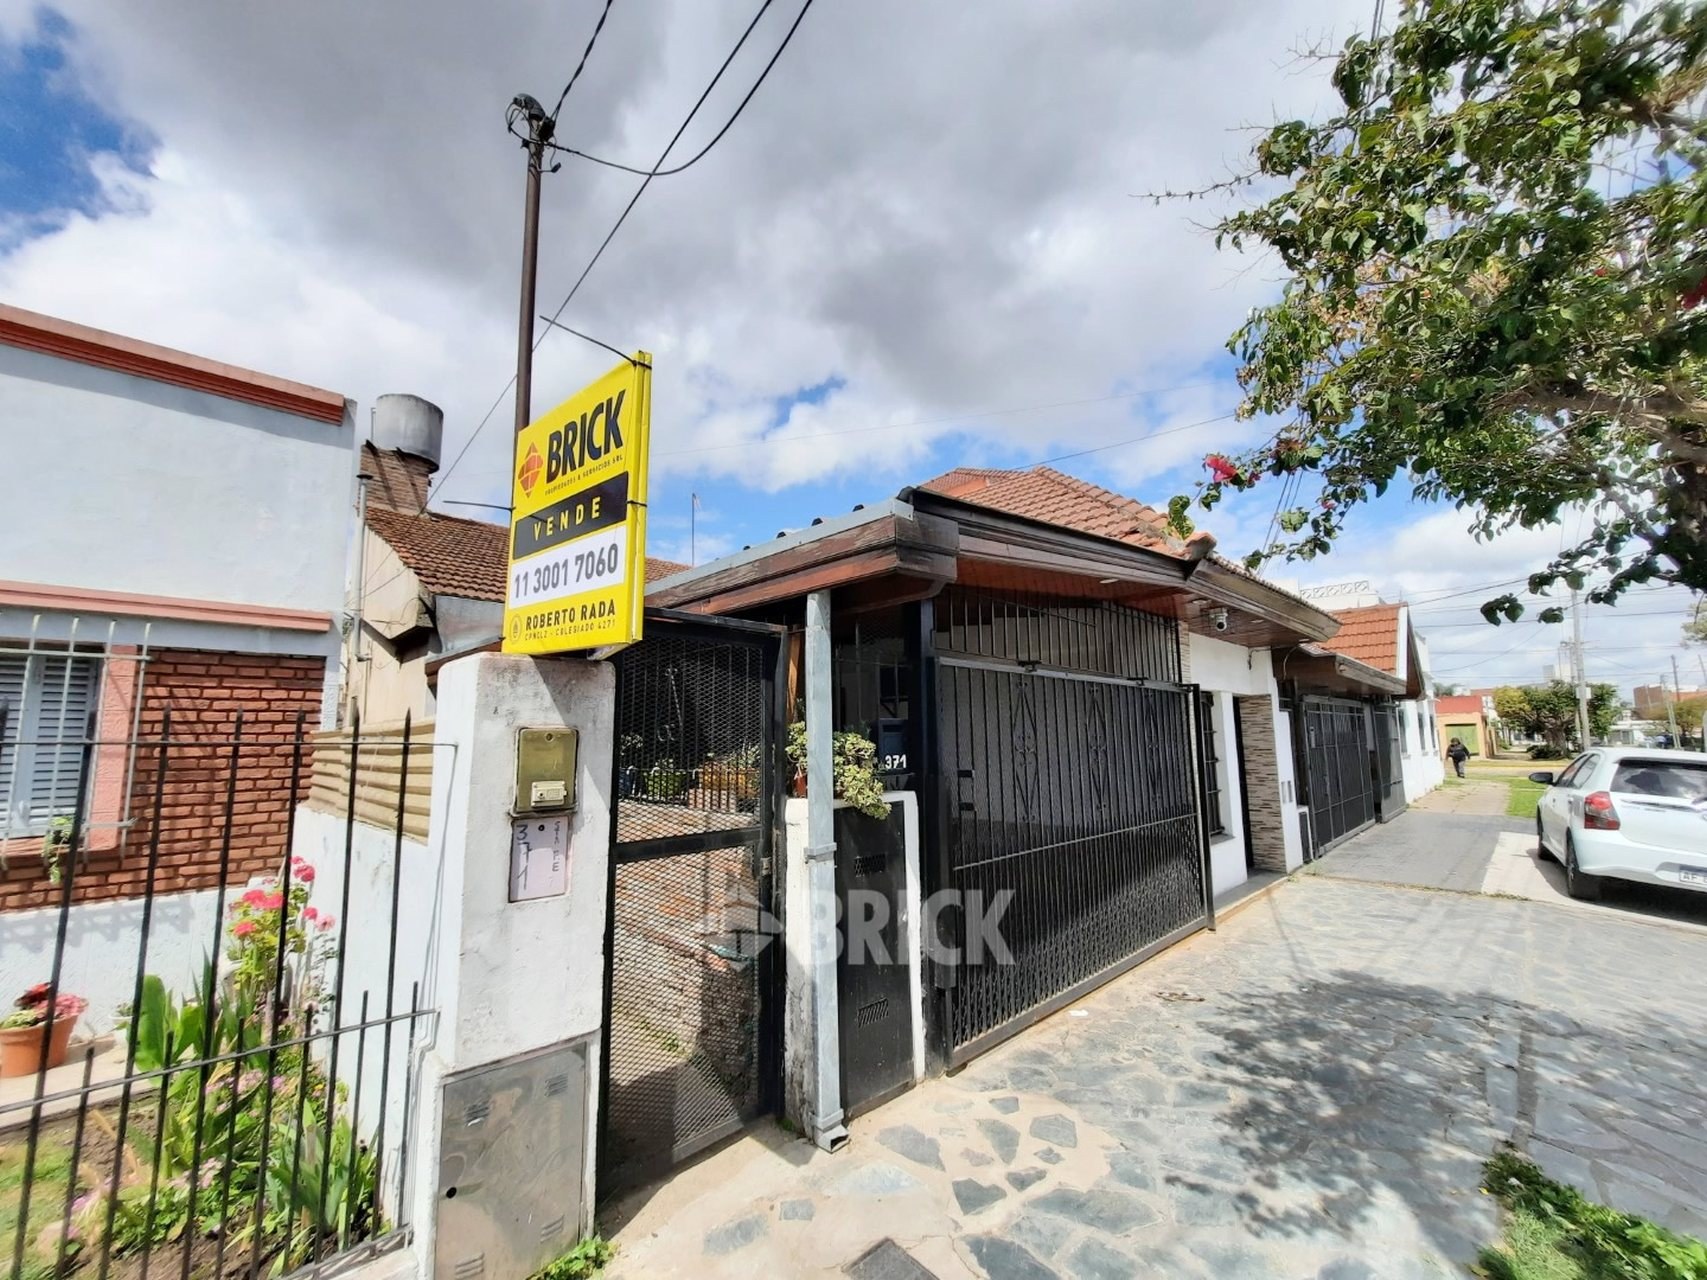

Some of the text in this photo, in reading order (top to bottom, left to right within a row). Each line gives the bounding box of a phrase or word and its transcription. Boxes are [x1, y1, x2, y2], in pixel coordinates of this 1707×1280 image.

[546, 389, 626, 484] BRICK
[533, 496, 601, 541] VENDE
[515, 543, 619, 599] 11 3001 7060
[525, 598, 616, 631] ROBERTO RADA
[885, 754, 907, 769] 371
